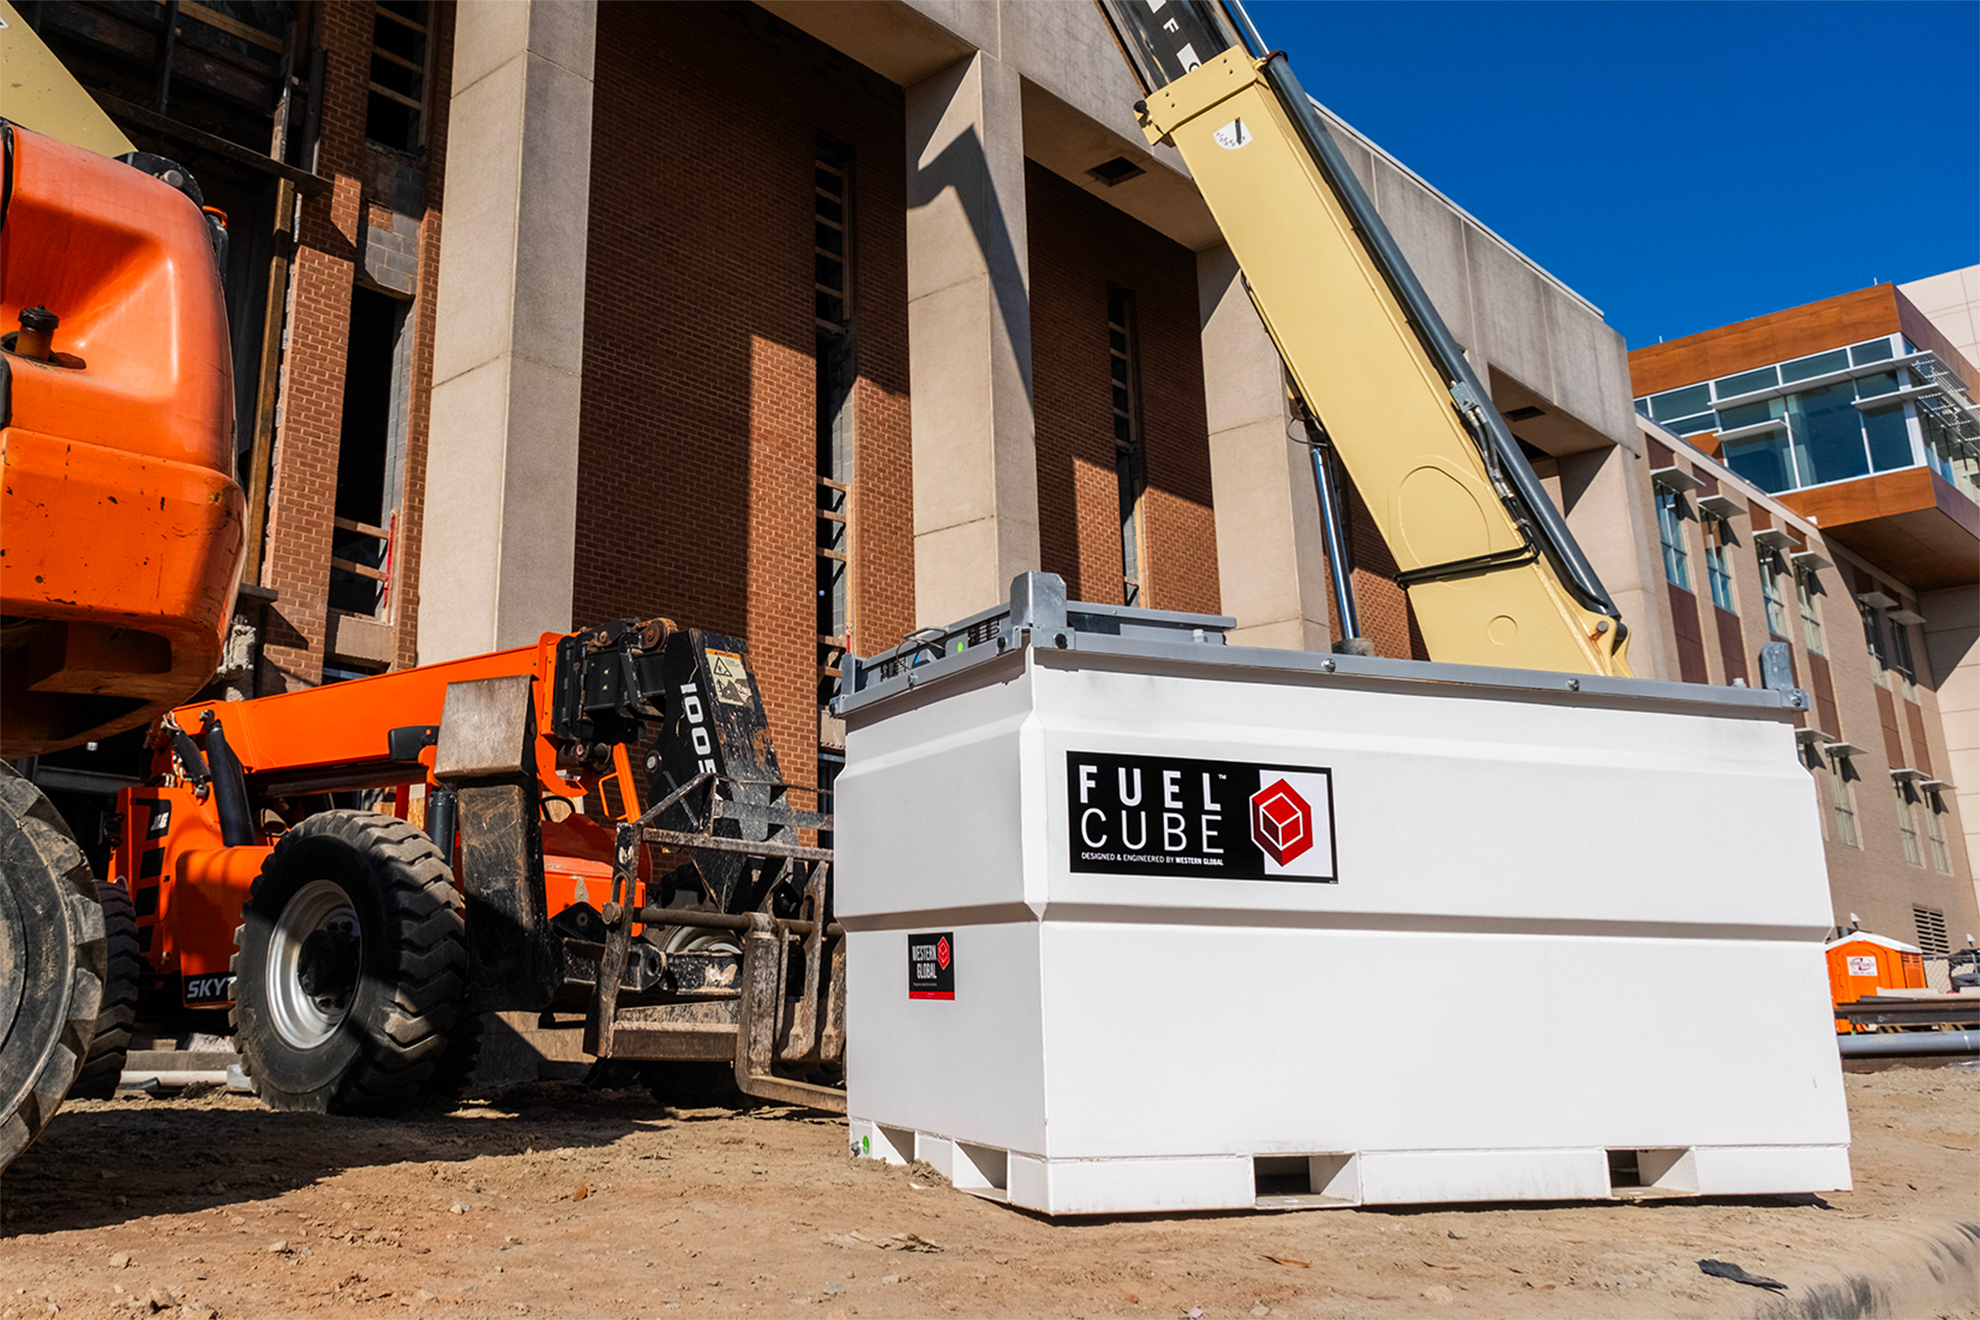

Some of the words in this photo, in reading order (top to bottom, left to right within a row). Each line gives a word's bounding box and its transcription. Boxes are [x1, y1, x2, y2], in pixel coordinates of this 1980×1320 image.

[1163, 17, 1180, 33] F
[680, 683, 724, 801] 1005
[1080, 807, 1225, 854] CUBE
[1081, 851, 1116, 862] DESIGNED
[1116, 853, 1122, 862] &
[1123, 853, 1165, 864] ENGINEERED
[1165, 855, 1174, 864] BY
[1175, 856, 1202, 865] WESTERN
[1203, 857, 1224, 867] GLOBAL
[916, 962, 937, 979] GLOBAL
